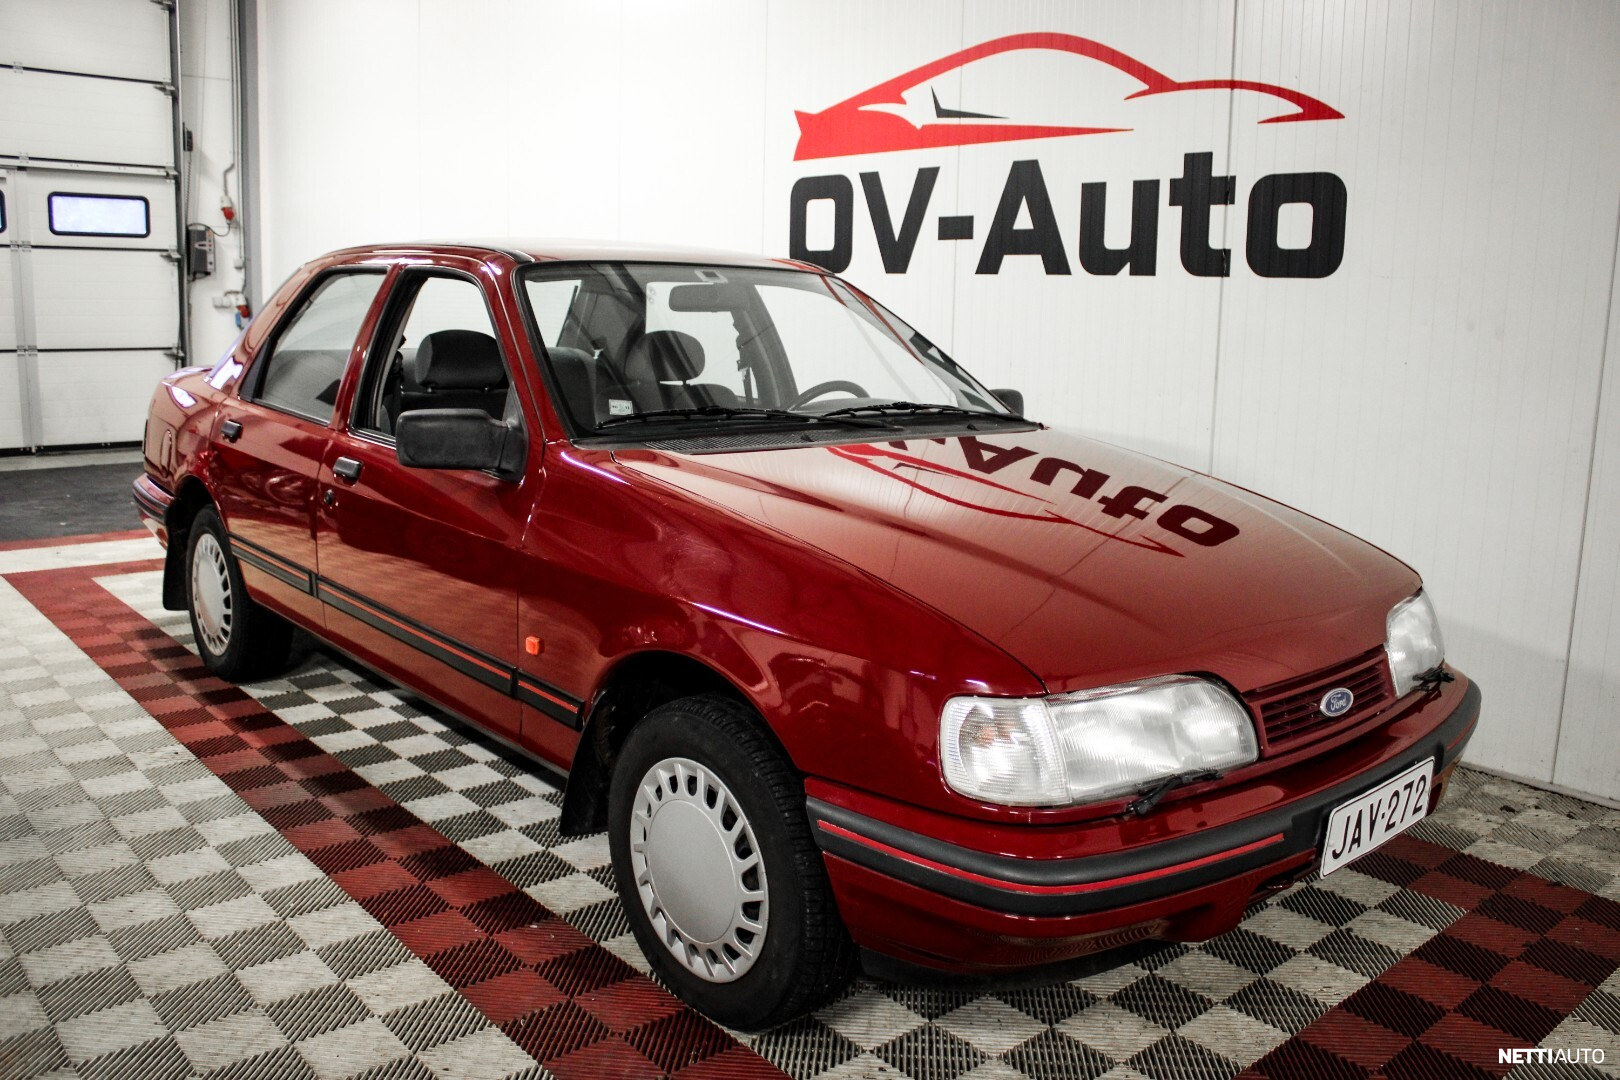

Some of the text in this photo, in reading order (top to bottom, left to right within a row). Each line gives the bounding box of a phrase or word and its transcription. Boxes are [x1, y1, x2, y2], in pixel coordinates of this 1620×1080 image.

[789, 151, 1348, 278] OV-Auto
[1330, 693, 1347, 711] Ford
[1331, 774, 1427, 860] JAV-272
